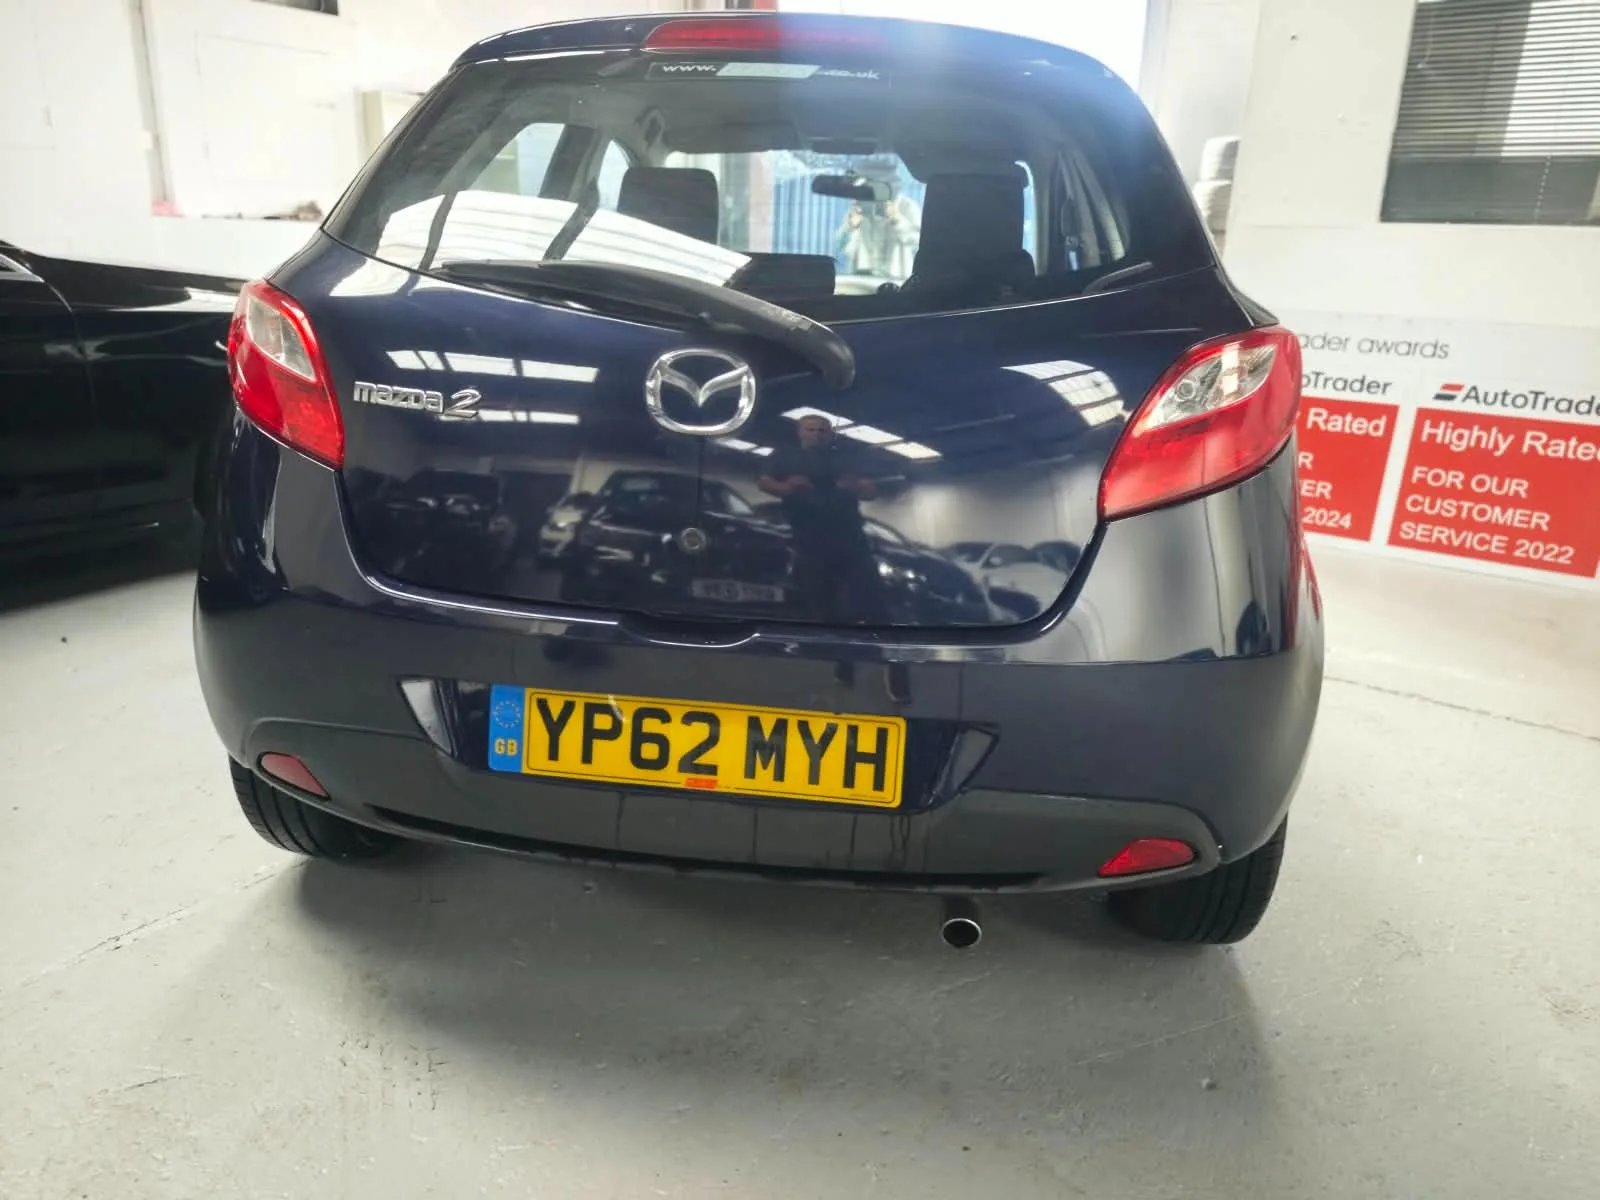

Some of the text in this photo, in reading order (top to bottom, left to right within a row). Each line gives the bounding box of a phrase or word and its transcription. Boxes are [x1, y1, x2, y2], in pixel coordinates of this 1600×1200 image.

[1357, 336, 1449, 360] awards
[1306, 407, 1387, 437] Rated
[1420, 419, 1600, 461] Highly Rate
[1411, 466, 1529, 499] FOR OUR
[1303, 506, 1352, 529] 2024
[1405, 494, 1550, 531] CUSTOMER
[1399, 521, 1575, 565] SERVICE 2022
[493, 738, 518, 757] GB
[535, 697, 890, 792] YP62 MYH
